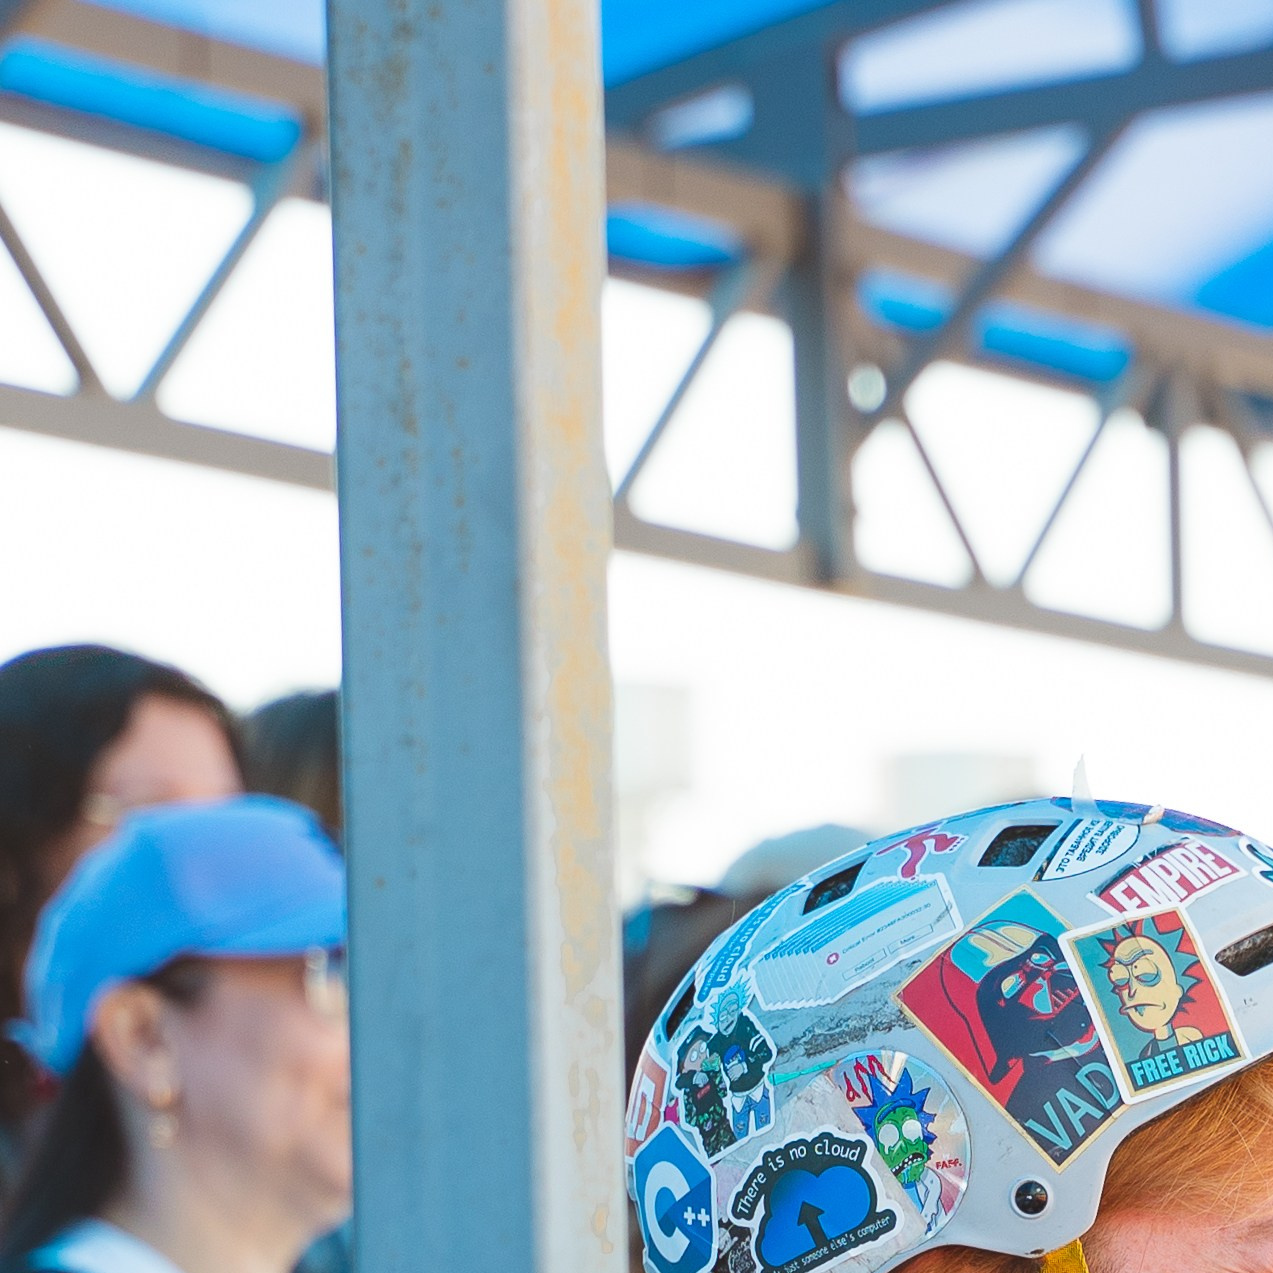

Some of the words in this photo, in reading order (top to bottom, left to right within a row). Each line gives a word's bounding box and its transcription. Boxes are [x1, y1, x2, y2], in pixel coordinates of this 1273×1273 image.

[1109, 844, 1233, 913] EMPIRE
[1130, 1052, 1185, 1087] FREE
[1183, 1033, 1235, 1070] RICK
[737, 1172, 767, 1214] There
[768, 1154, 785, 1172] is
[789, 1144, 807, 1161] no
[814, 1139, 861, 1162] cloud
[801, 1246, 829, 1266] someone
[830, 1233, 856, 1250] else's
[857, 1215, 891, 1239] computer
